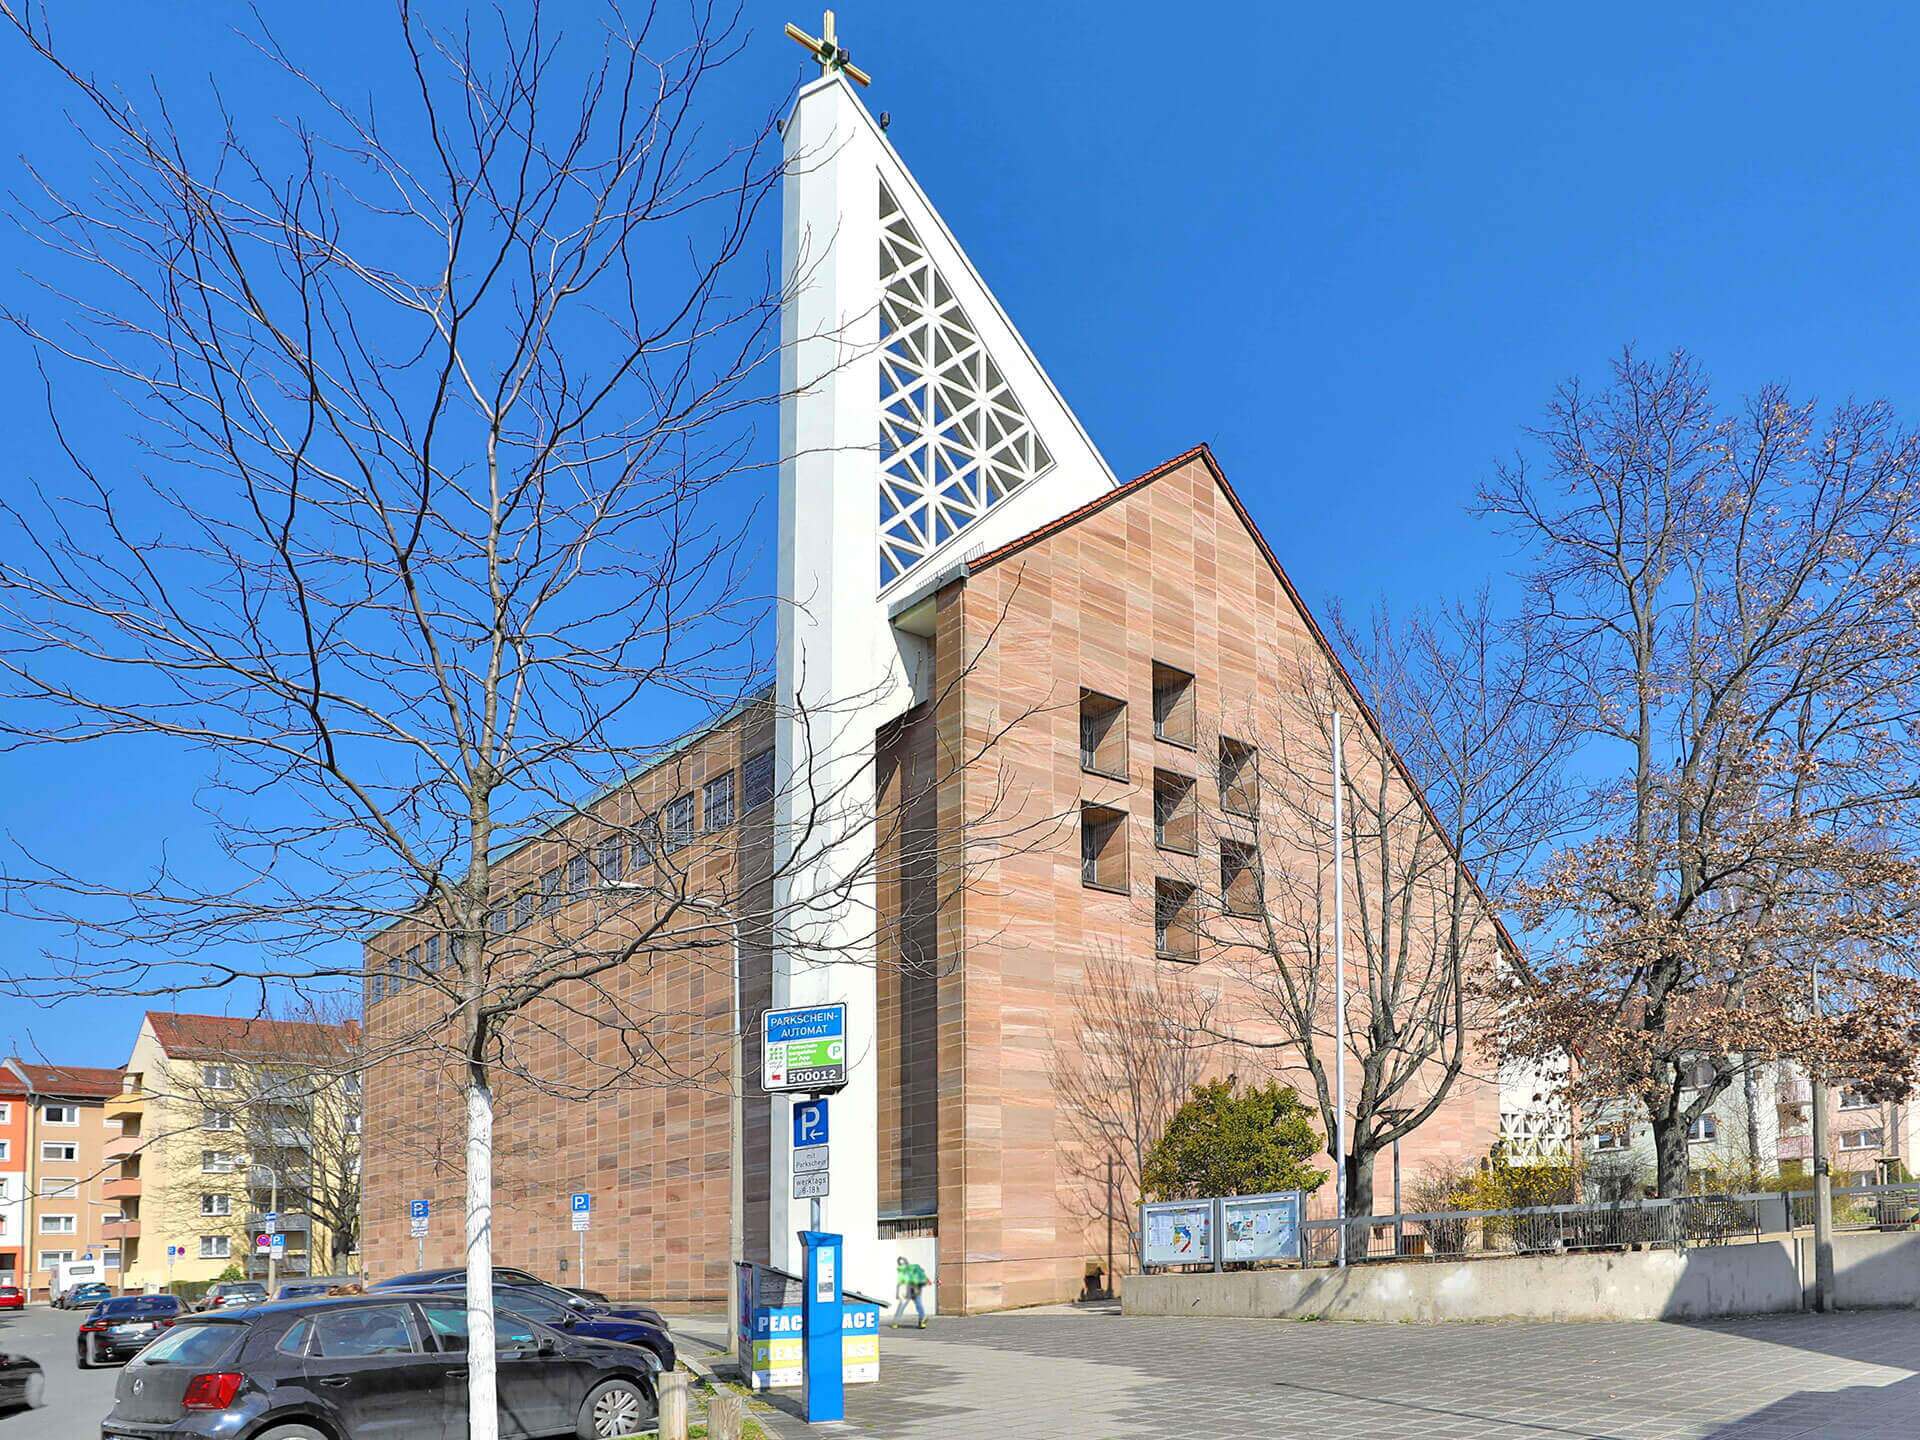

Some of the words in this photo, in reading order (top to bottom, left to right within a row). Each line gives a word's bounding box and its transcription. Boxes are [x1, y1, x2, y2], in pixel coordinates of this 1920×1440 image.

[770, 1012, 838, 1027] PARKSCHEIN-
[781, 1024, 828, 1038] AUTOMAT
[832, 1046, 841, 1057] P
[789, 1069, 836, 1082] 500012
[801, 1106, 820, 1141] P
[796, 1176, 827, 1187] werktags
